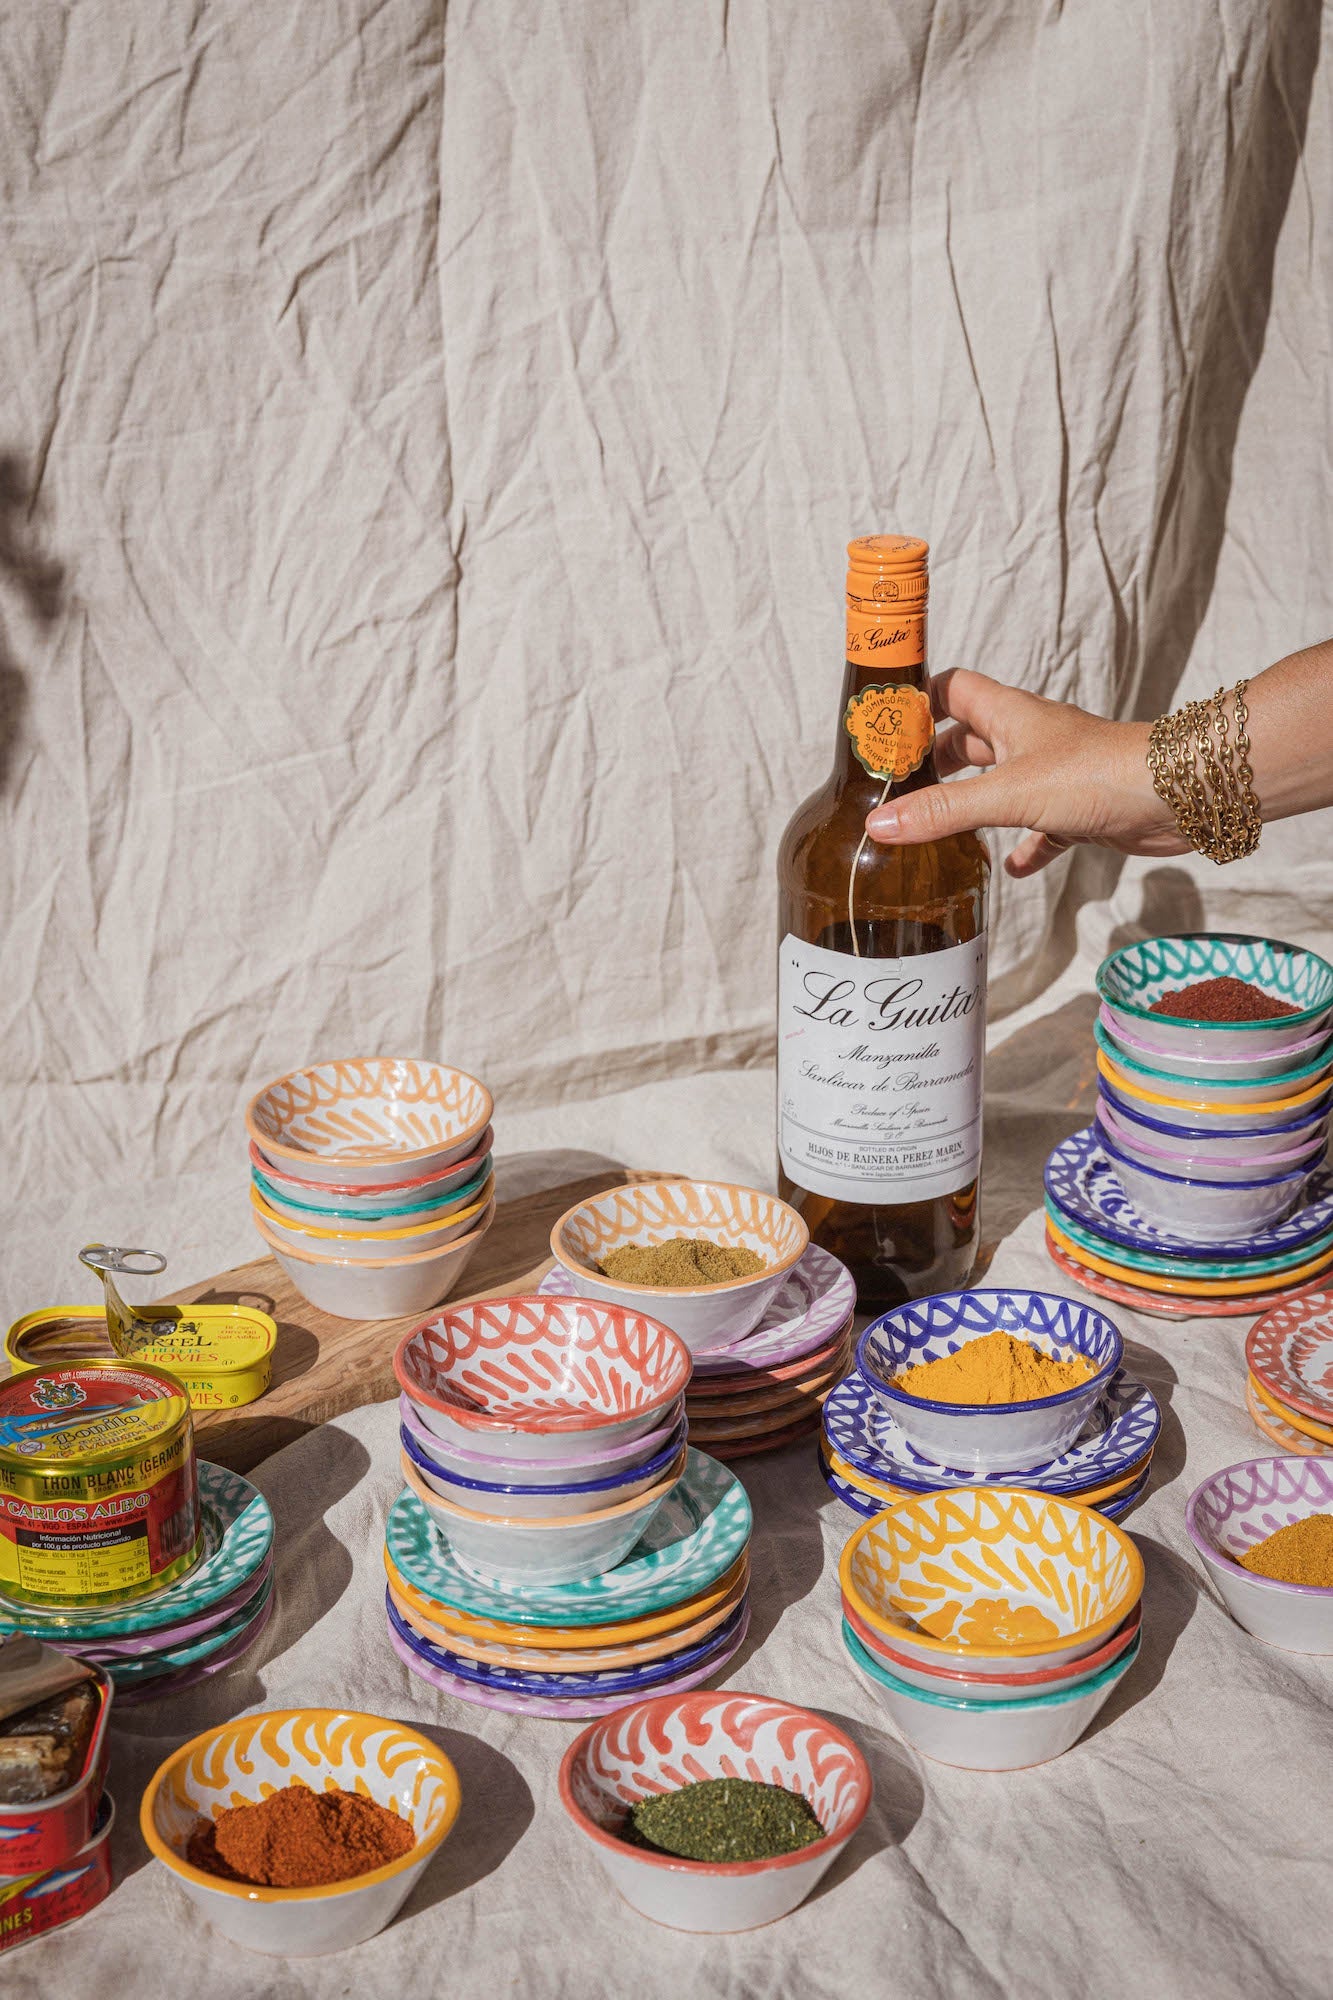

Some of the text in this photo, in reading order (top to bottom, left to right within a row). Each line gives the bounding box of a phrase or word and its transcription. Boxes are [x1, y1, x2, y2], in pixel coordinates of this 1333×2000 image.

[862, 696, 896, 717] DOMINGO
[838, 1042, 941, 1070] Manzanilla
[871, 1075, 889, 1092] de
[892, 1058, 975, 1092] Barrameda
[850, 1102, 930, 1119] Produce of Spain
[808, 1142, 834, 1158] HIJOS
[836, 1151, 850, 1162] DE
[853, 1153, 899, 1165] RAINERA
[902, 1150, 933, 1163] PEREZ
[51, 1415, 140, 1445] Bonito
[42, 1477, 81, 1490] THON
[87, 1466, 135, 1487] BLANC
[8, 1500, 88, 1521] CARLOS
[91, 1492, 151, 1520] ALBO
[40, 1529, 121, 1543] Información Nutricional
[42, 1522, 60, 1530] VIGO
[72, 1542, 100, 1550] producto
[102, 1535, 131, 1546] escurrido
[0, 1906, 33, 1937] INES
